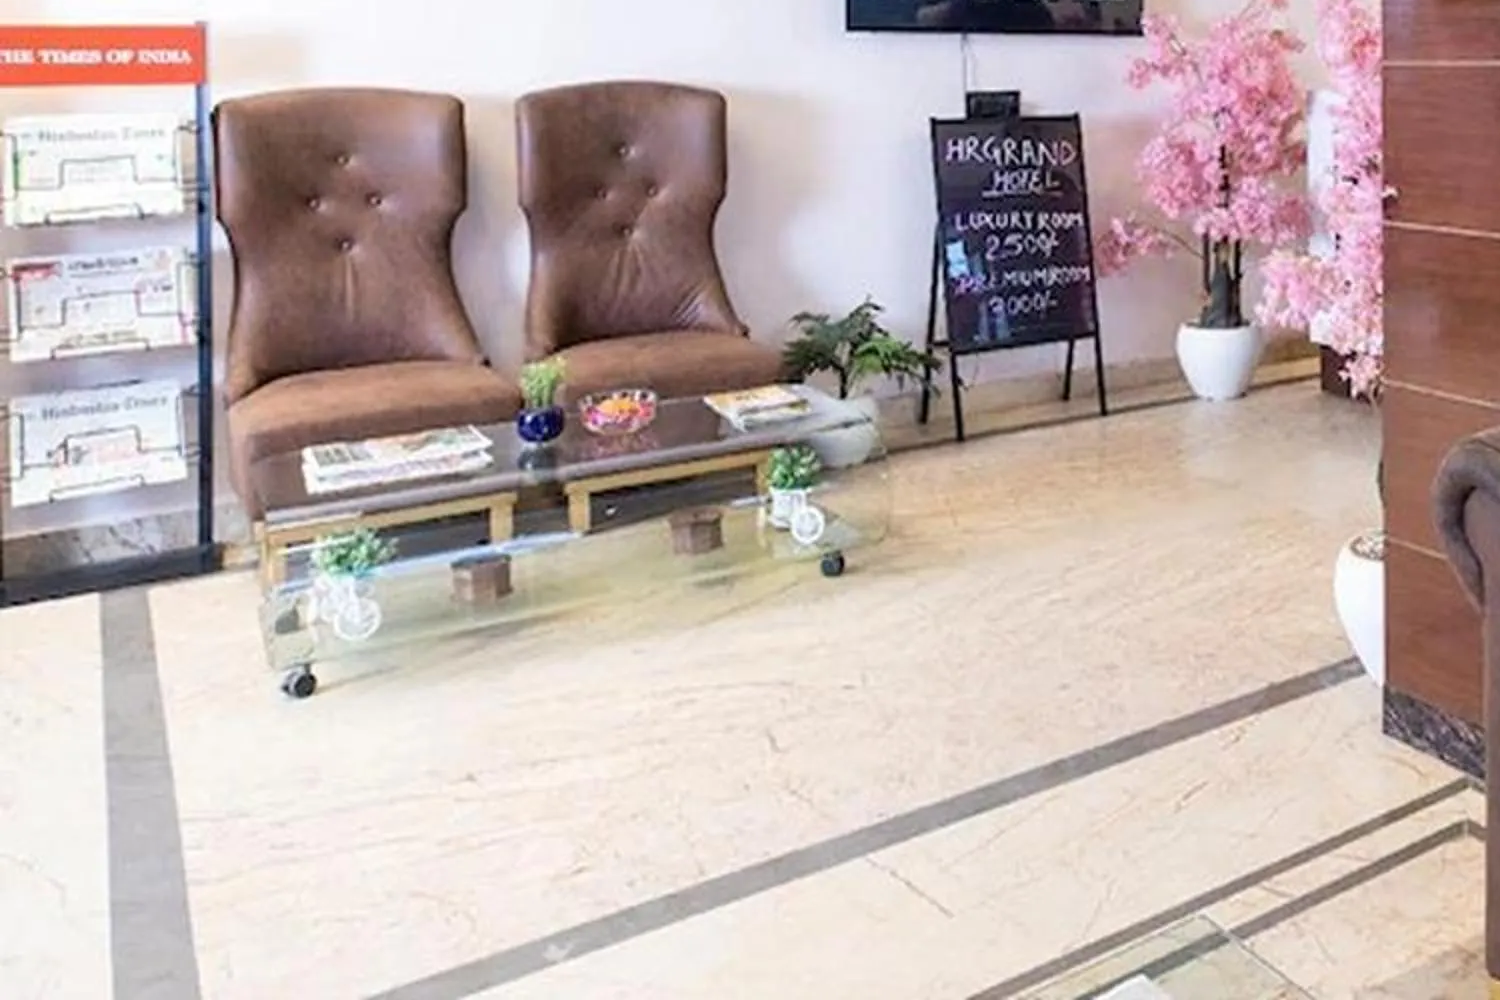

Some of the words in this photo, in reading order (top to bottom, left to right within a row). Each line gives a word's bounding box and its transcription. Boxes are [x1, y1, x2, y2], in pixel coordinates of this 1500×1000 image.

[36, 48, 102, 64] TIMES
[105, 49, 134, 64] OF
[138, 48, 193, 65] INDIA
[993, 169, 1060, 193] HOTEL
